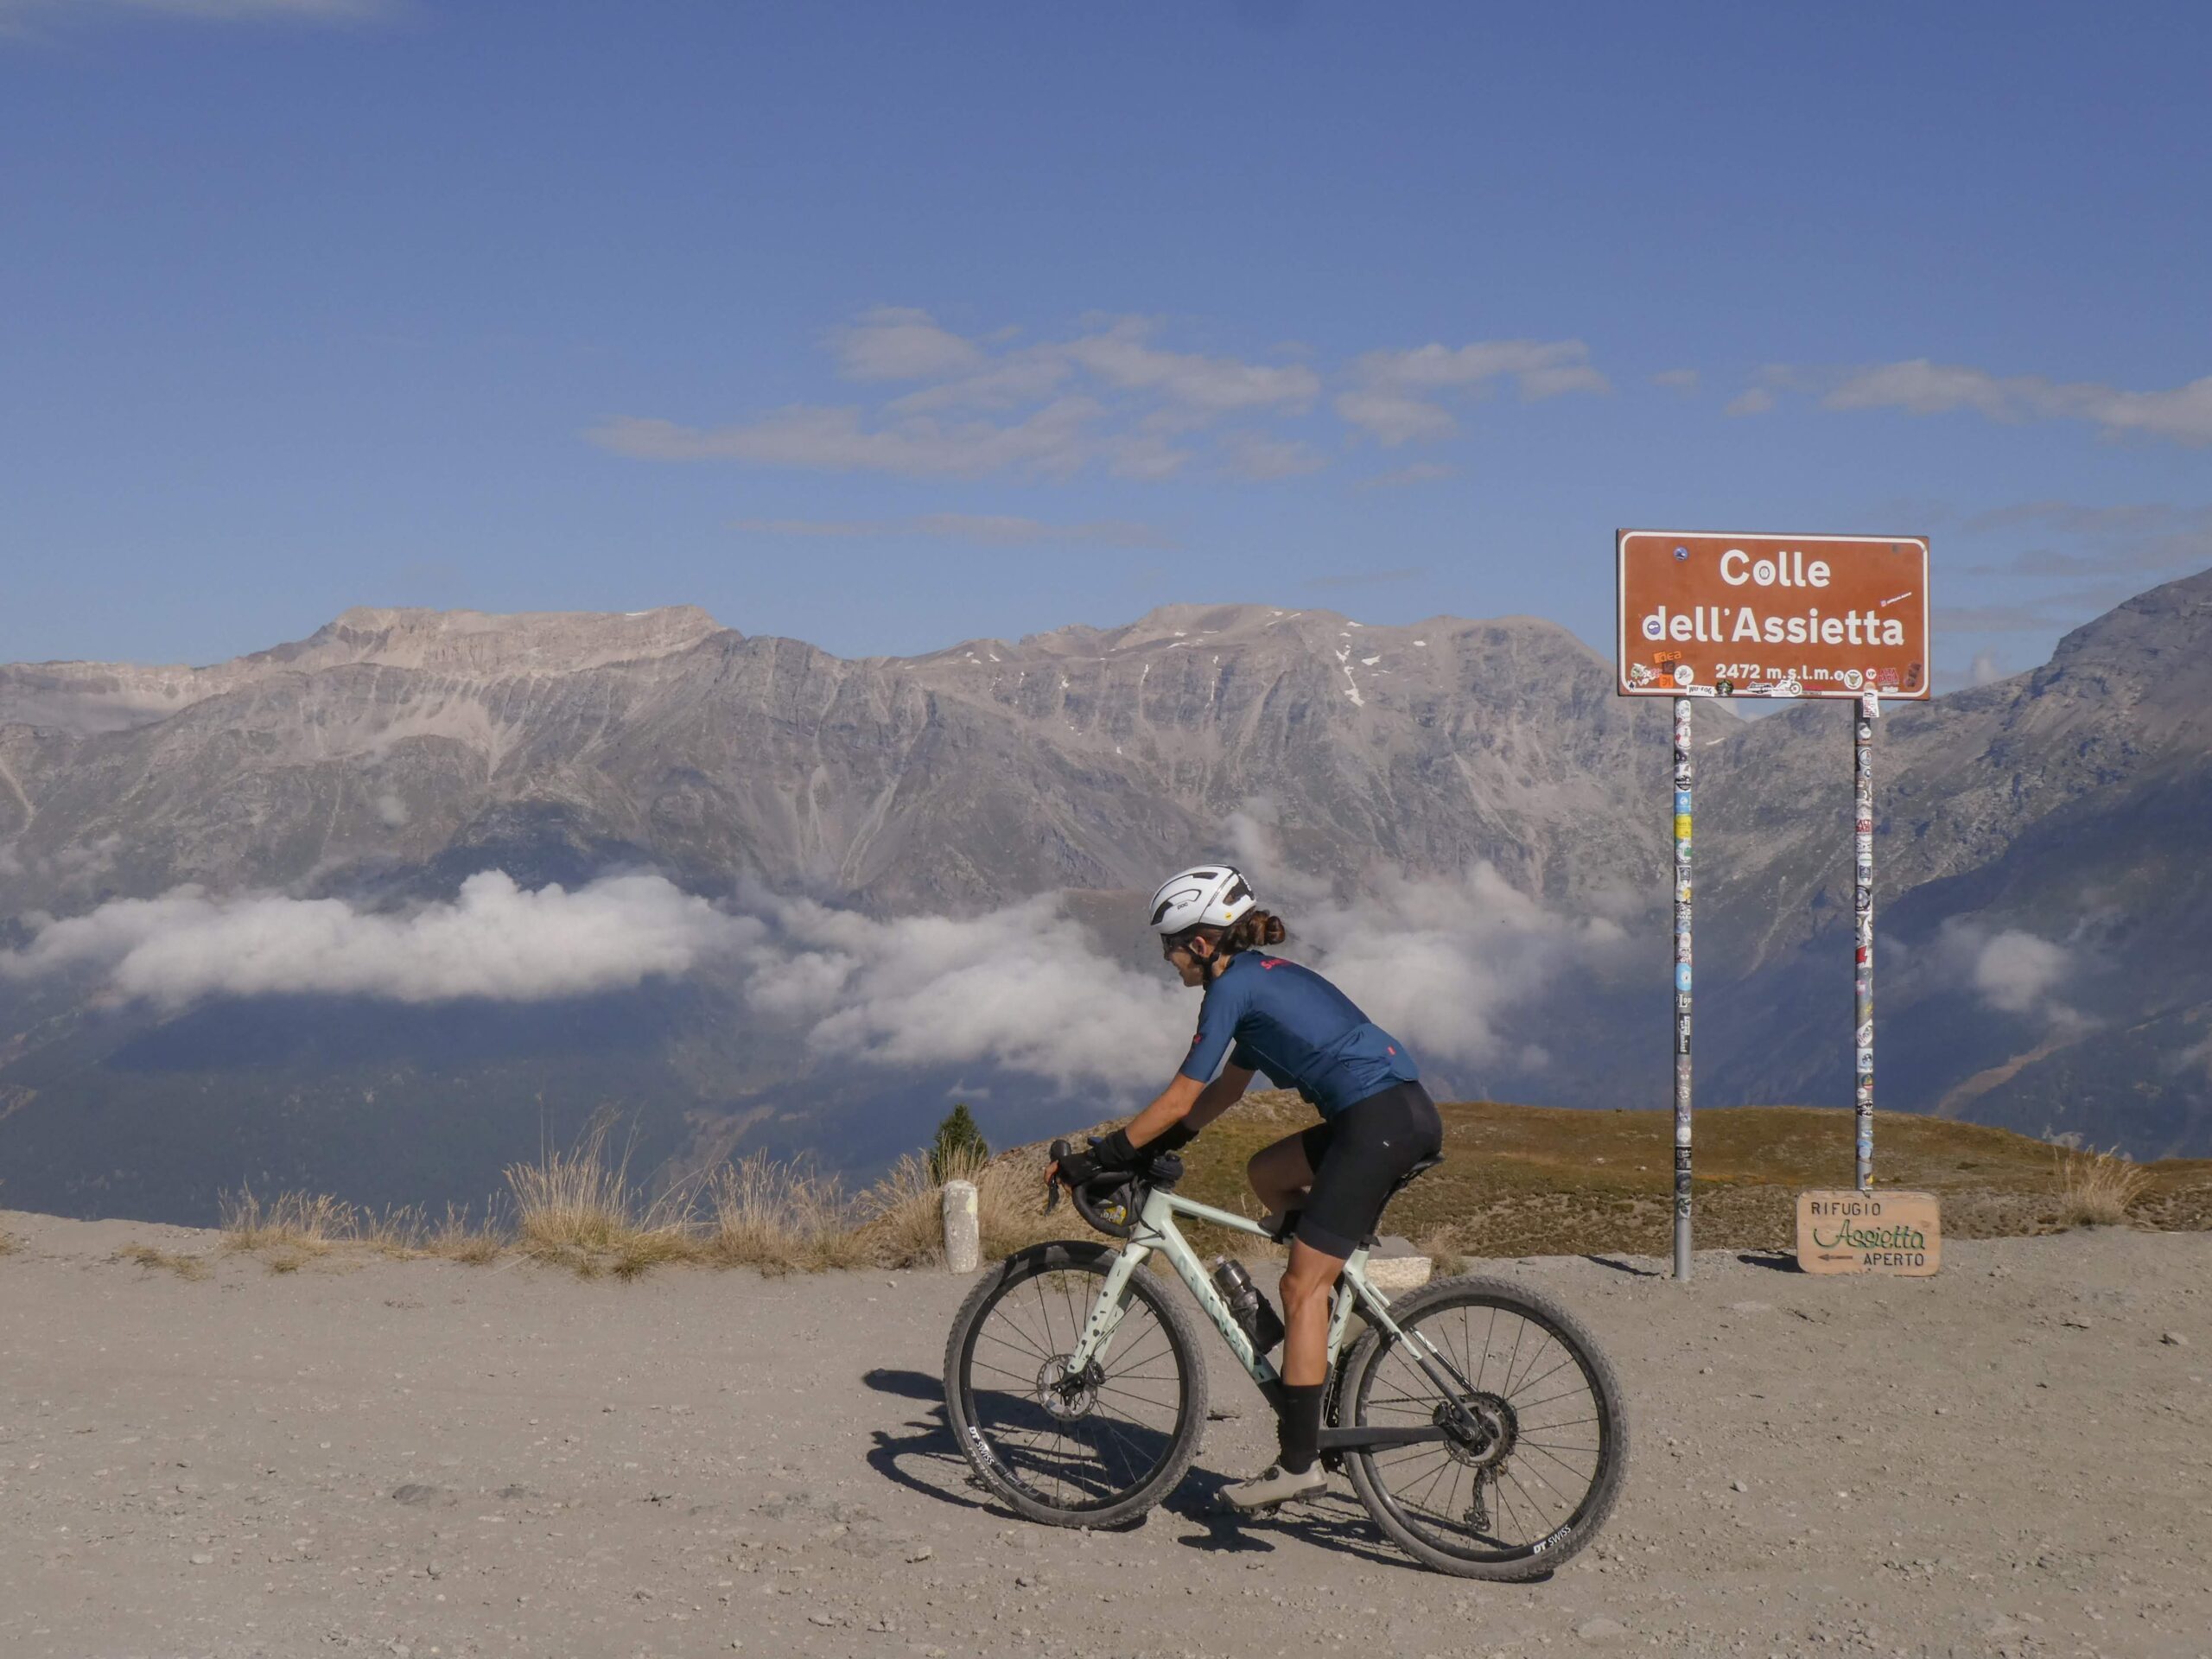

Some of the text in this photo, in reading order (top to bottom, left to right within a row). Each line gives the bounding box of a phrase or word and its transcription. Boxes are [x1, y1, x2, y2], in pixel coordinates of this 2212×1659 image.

[1720, 550, 1831, 587] Colle
[1643, 606, 1904, 645] dell'Assietta
[1715, 664, 1834, 680] 2472 m.s.l.m.
[1811, 1202, 1881, 1216] RIFUGIO
[1814, 1219, 1925, 1249] Assietta
[1864, 1253, 1924, 1266] APERTO
[969, 1427, 995, 1465] DT SWISS
[1534, 1524, 1571, 1554] DT SWISS
